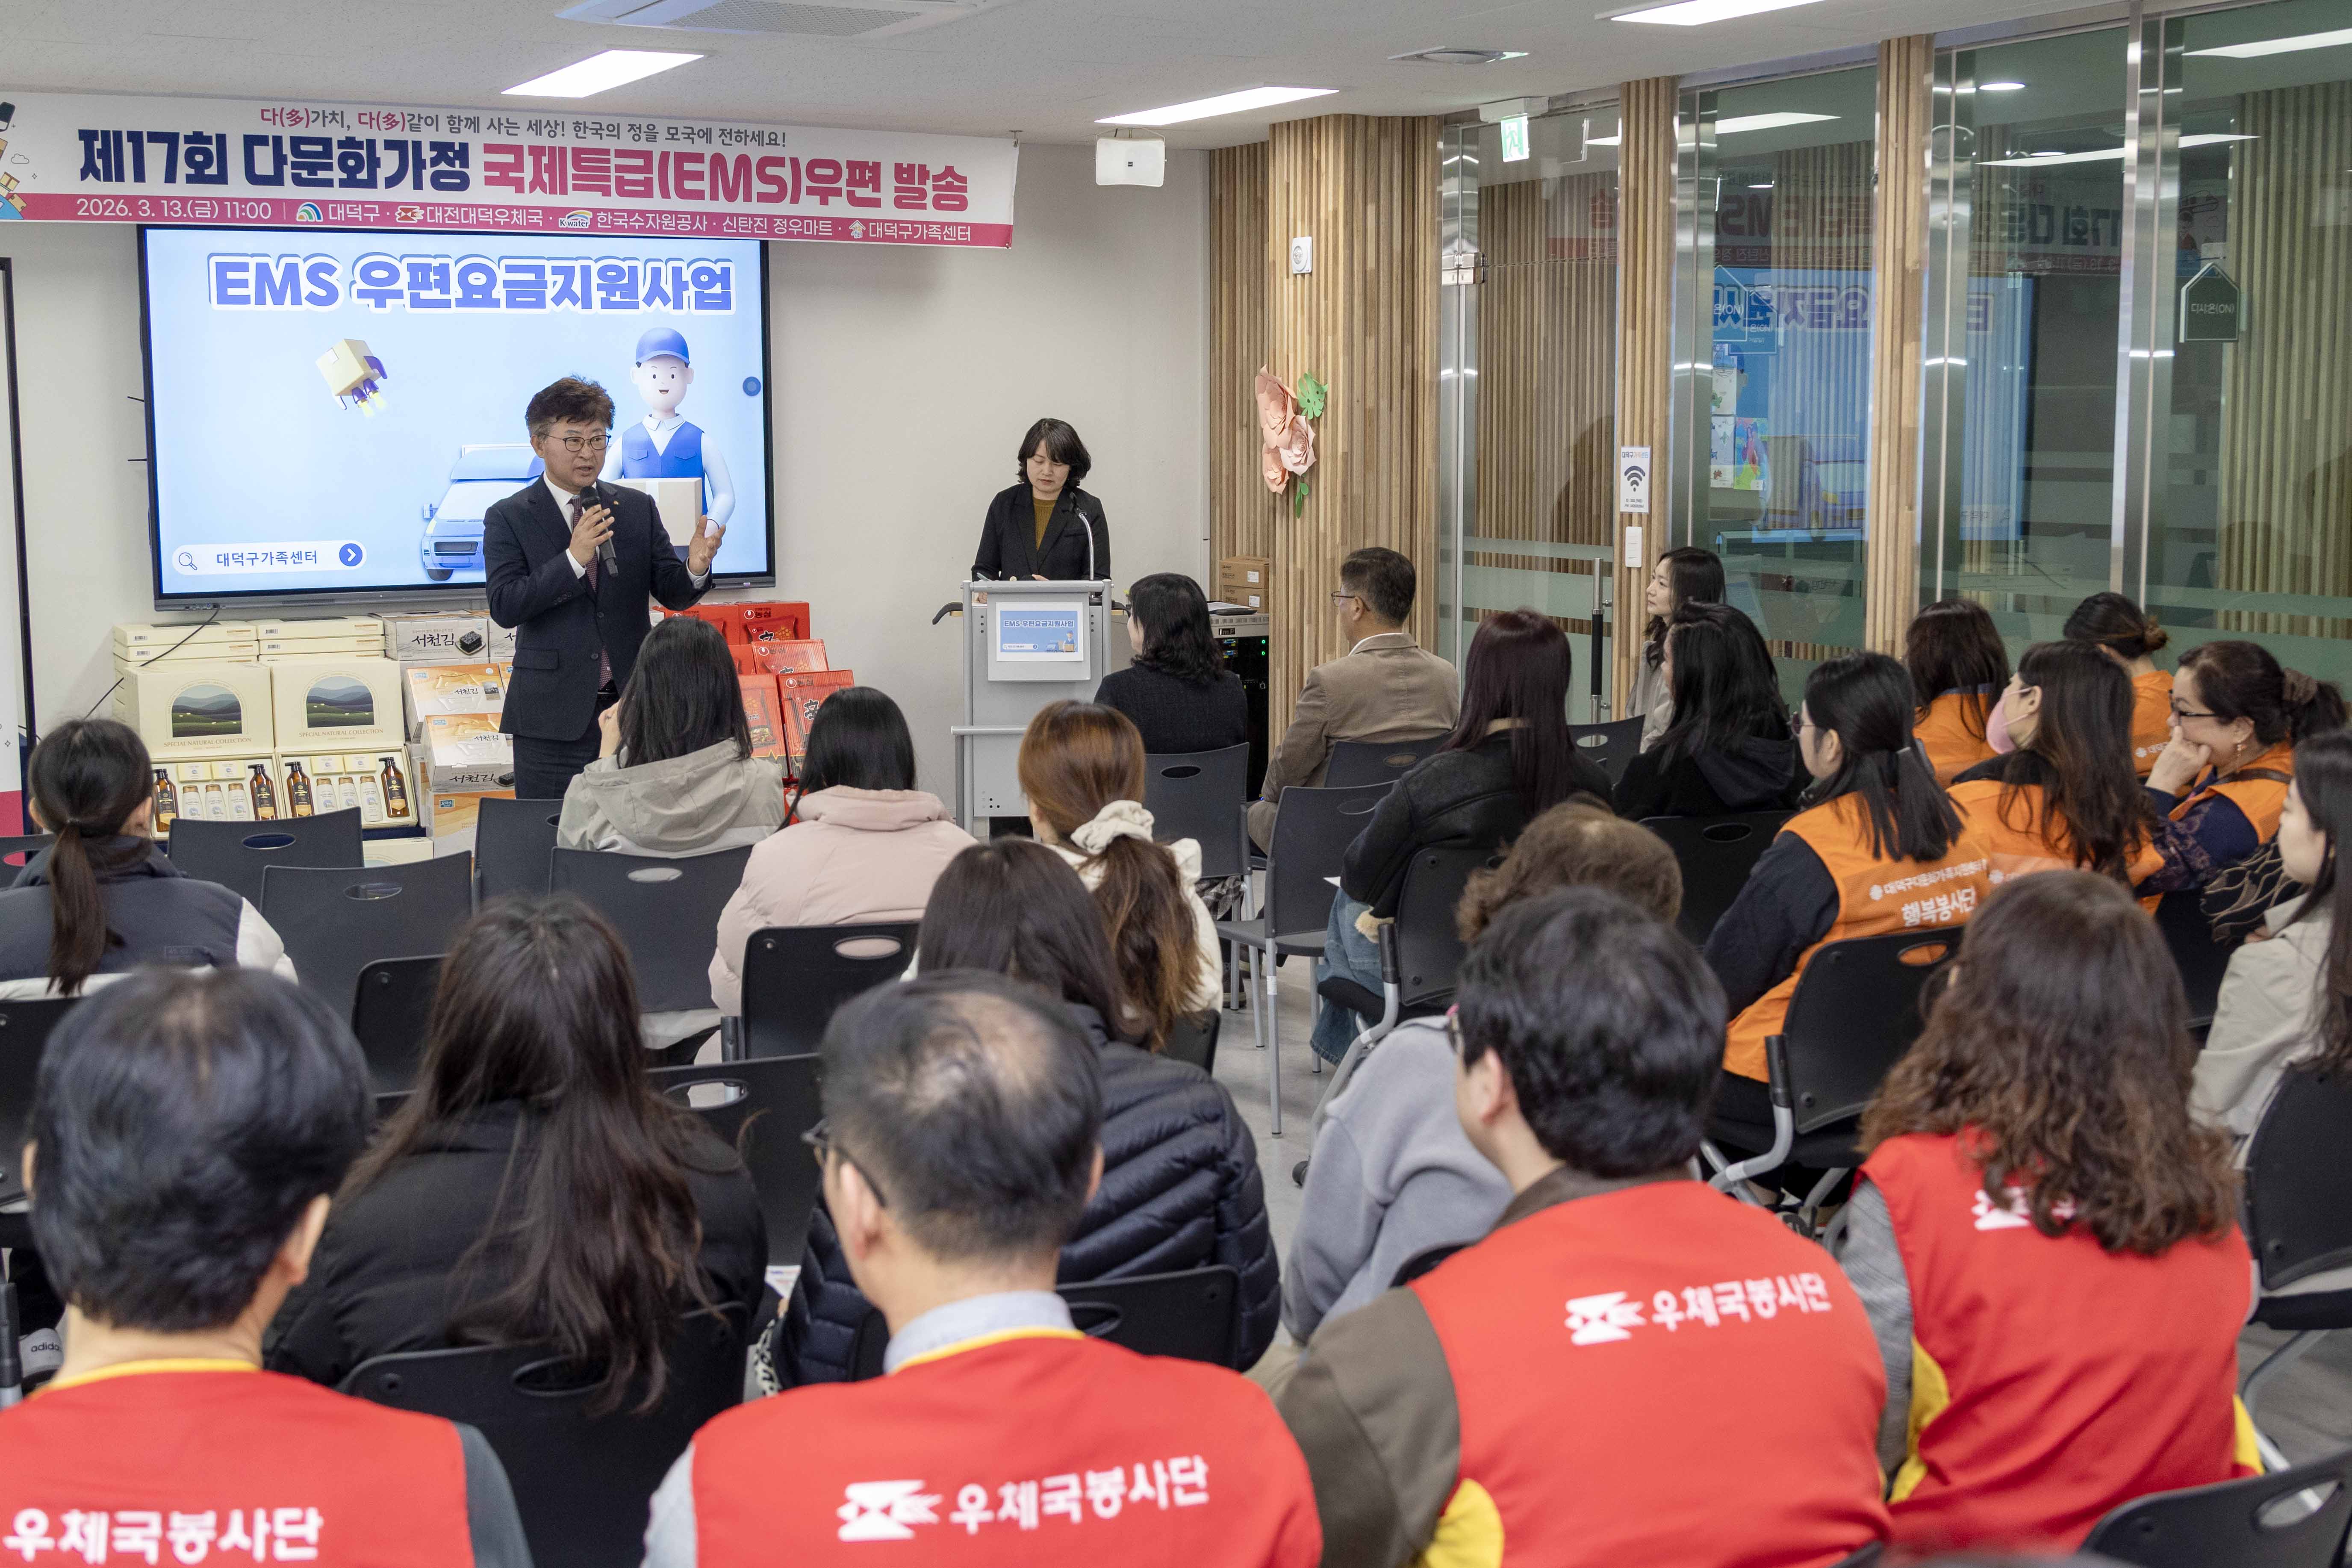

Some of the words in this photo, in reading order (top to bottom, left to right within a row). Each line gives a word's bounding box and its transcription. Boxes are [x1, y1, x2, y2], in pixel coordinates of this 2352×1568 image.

[261, 107, 351, 130] 다(多)가치,
[357, 111, 439, 132] 다(多)같이
[447, 114, 480, 133] 함께
[486, 117, 520, 136] 사는
[526, 119, 565, 138] 세상!
[572, 121, 620, 140] 한국의
[627, 123, 659, 142] 정을
[665, 126, 712, 144] 모국에
[718, 127, 786, 147] 전하세요!
[78, 129, 229, 185] 제17회
[243, 134, 471, 192] 다문화가정
[483, 143, 881, 208] 국제특급(EMS)우편
[893, 162, 968, 212] 발송
[77, 198, 132, 217] 2026.
[139, 199, 155, 217] 3.
[161, 199, 218, 219] 13.(금)
[226, 201, 272, 220] 11:00
[329, 203, 380, 223] 대덕구
[427, 206, 543, 226] 대전대덕우체국
[597, 212, 707, 232] 한국수자원공사
[722, 219, 767, 234] 신탄진
[773, 220, 833, 236] 정우마트
[869, 222, 971, 242] 대덕구가족센터
[215, 261, 340, 307] EMS
[353, 260, 733, 311] 우편요금지원사업
[217, 548, 318, 567] 대덕구가족센터
[411, 633, 455, 648] 서천김
[454, 687, 479, 696] 서천김
[449, 773, 495, 784] 서천김
[1901, 886, 1976, 927] 행복봉사단
[1652, 1272, 1833, 1332] 우체국봉사단
[31, 1342, 63, 1352] adida
[949, 1454, 1210, 1536] 우체국봉사단
[2, 1507, 324, 1565] 우체국봉사단
